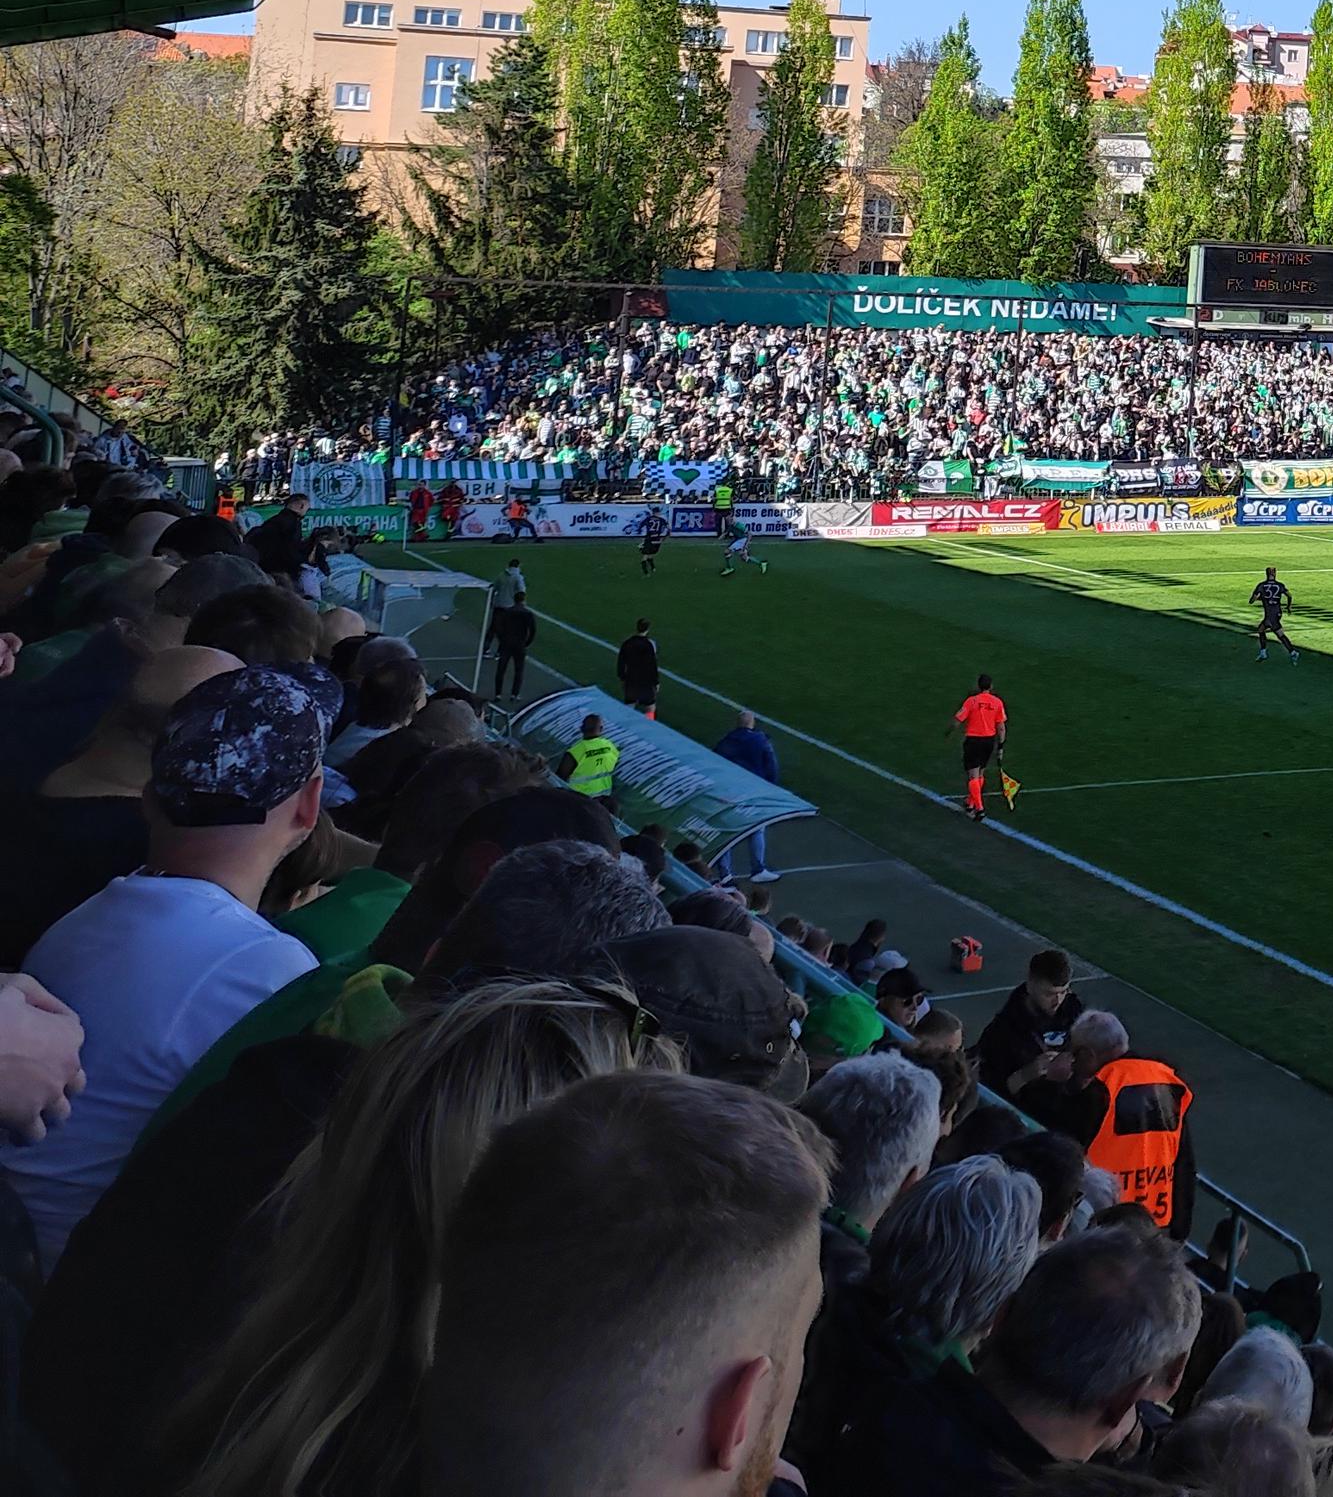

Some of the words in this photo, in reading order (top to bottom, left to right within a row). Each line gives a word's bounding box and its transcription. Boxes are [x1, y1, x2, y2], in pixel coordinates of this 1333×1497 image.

[1236, 250, 1313, 266] BOHEMIANS
[853, 286, 982, 317] ĎOLÍČEK
[990, 293, 1118, 322] NEDÁME!
[892, 504, 1042, 521] REMAL.CZ
[1081, 503, 1190, 527] IMPULS
[1259, 501, 1287, 516] ČPP
[1165, 522, 1212, 531] REMAL
[1263, 584, 1281, 599] 32
